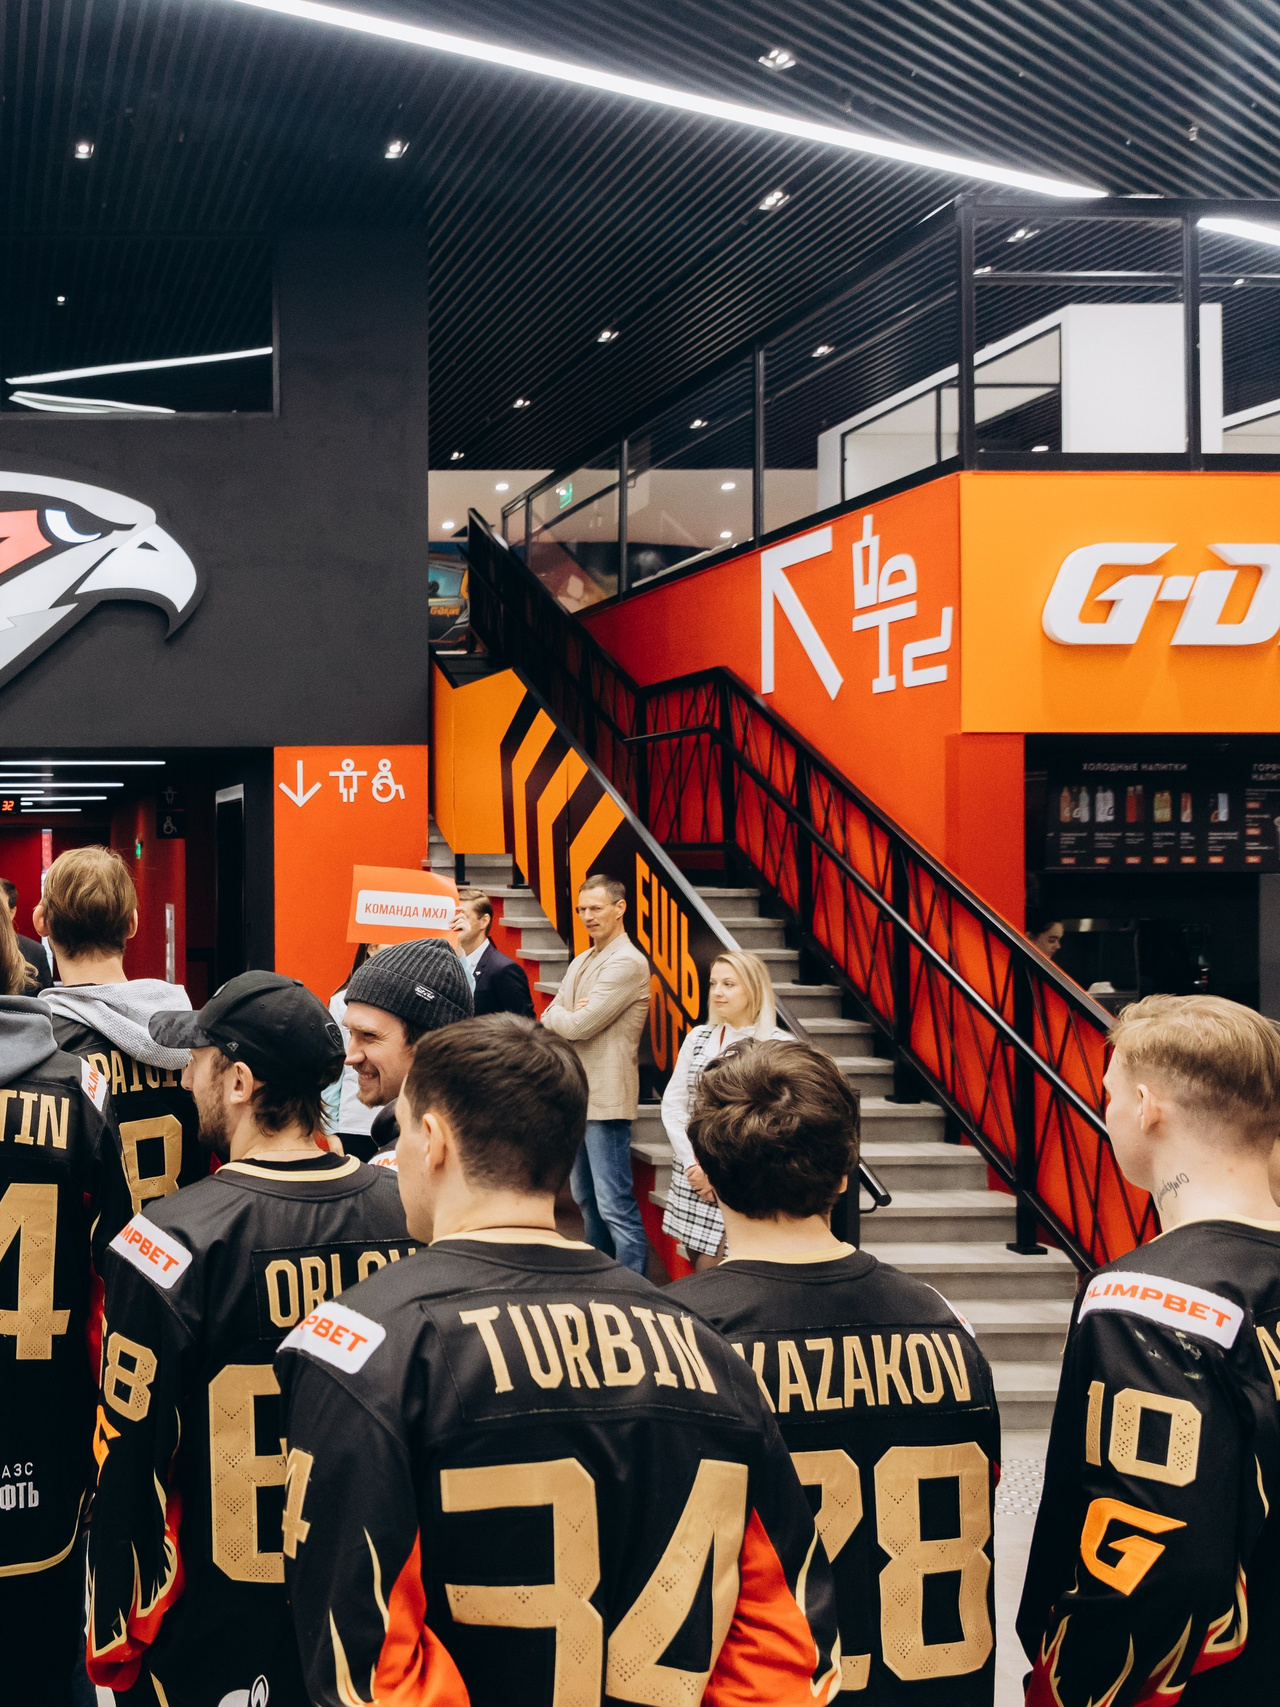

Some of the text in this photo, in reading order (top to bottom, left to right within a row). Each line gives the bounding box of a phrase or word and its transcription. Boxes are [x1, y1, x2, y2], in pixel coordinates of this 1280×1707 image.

[2, 800, 14, 811] 32
[1141, 762, 1188, 771] НАПИТКИ
[1252, 763, 1280, 772] ГОРЯ
[364, 903, 447, 919] КОМАНДА МХЛ
[636, 852, 700, 1021] ЕШЬ
[650, 973, 694, 1075] ОТ
[100, 1313, 158, 1422] 8
[296, 1314, 368, 1352] PBET
[459, 1300, 718, 1395] TURBIN
[730, 1331, 972, 1414] KAZAKOV
[1, 1461, 33, 1479] АЗС
[1085, 1380, 1202, 1487] 10
[440, 1457, 749, 1707] 34
